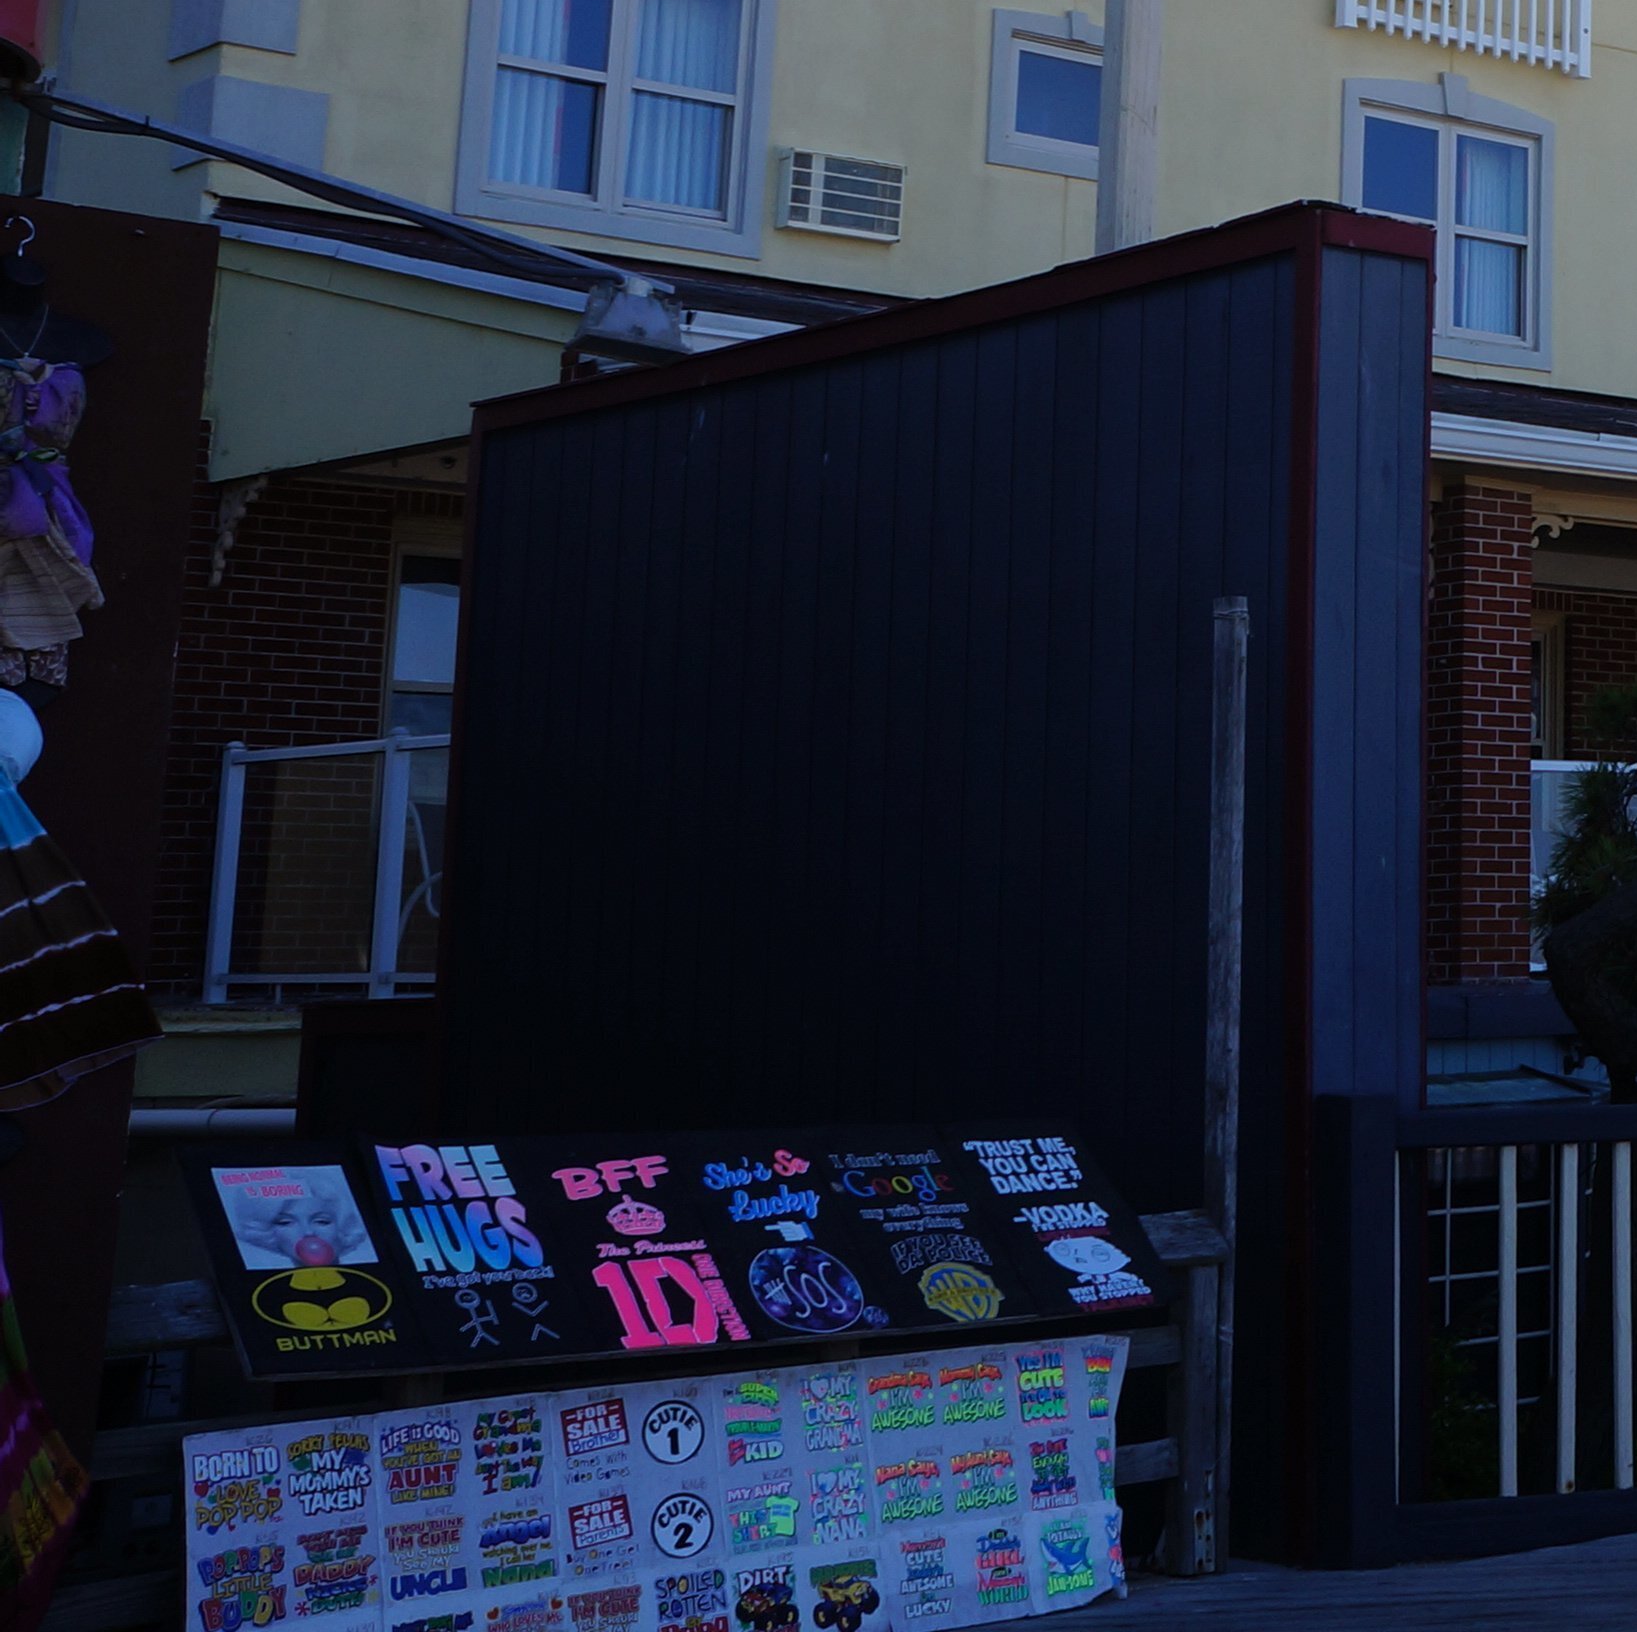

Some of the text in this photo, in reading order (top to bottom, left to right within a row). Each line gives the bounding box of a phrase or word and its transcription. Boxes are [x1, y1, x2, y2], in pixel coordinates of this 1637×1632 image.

[1035, 1136, 1076, 1155] ME,
[374, 1144, 517, 1201] FREE
[703, 1148, 810, 1190] She's So
[980, 1153, 1077, 1176] YOU CAN
[551, 1154, 669, 1201] BFF
[842, 1166, 957, 1202] Google
[260, 1184, 305, 1198] BORING
[728, 1184, 820, 1222] Lucky
[390, 1197, 544, 1272] HUGS
[596, 1243, 631, 1258] The
[925, 1247, 993, 1266] POLICE
[592, 1256, 719, 1349] 1D
[275, 1329, 397, 1351] BUTTMAN
[831, 1375, 853, 1397] MY
[961, 1381, 985, 1402] I'M
[1018, 1368, 1065, 1391] CUTE
[890, 1387, 914, 1409] I'M
[648, 1406, 698, 1434] CUTIE
[804, 1402, 858, 1426] CRAZY
[871, 1405, 936, 1433] AWESOME
[943, 1397, 1006, 1425] AWESOME
[1021, 1399, 1069, 1423] LOOK
[381, 1421, 461, 1456] LIFE GOOD
[566, 1414, 622, 1441] SALE
[287, 1435, 324, 1460] SORRY
[667, 1428, 680, 1455] 1
[745, 1439, 784, 1464] KID
[193, 1446, 280, 1483] BORN TO
[312, 1449, 345, 1471] MY
[566, 1455, 601, 1470] Comes
[389, 1464, 457, 1491] AUNT
[482, 1473, 498, 1495] I
[564, 1465, 630, 1486] Video Games
[838, 1467, 862, 1492] MY
[876, 1463, 908, 1486] Nana
[971, 1464, 994, 1488] I'M
[216, 1479, 260, 1504] LOVE
[299, 1490, 365, 1516] TAKEN
[727, 1480, 792, 1504] MY AUNT
[955, 1483, 1018, 1515] AWESOME
[196, 1497, 282, 1530] POP POP
[658, 1499, 707, 1528] CUTIE
[729, 1508, 767, 1527] THIS
[811, 1494, 866, 1520] CRAZY
[881, 1493, 945, 1524] AWESOME
[385, 1517, 464, 1538] IF YOU THINK
[573, 1509, 626, 1535] SALE
[733, 1523, 777, 1544] SHIRT
[817, 1517, 866, 1545] NANA
[388, 1536, 413, 1553] I'M
[419, 1529, 461, 1547] CUTE
[674, 1522, 694, 1550] 2
[432, 1555, 452, 1567] MY
[589, 1548, 612, 1560] One
[906, 1548, 943, 1566] CUTE
[294, 1555, 376, 1587] DADDY
[574, 1565, 598, 1576] One
[737, 1566, 788, 1596] DIRT
[213, 1574, 273, 1599] LITTLE
[391, 1566, 467, 1601] UNCLE
[655, 1569, 725, 1599] SPOILED
[900, 1572, 954, 1596] AWESOME
[200, 1584, 286, 1632] BUDDY
[657, 1594, 727, 1619] ROTTEN
[905, 1597, 951, 1619] LUCKY
